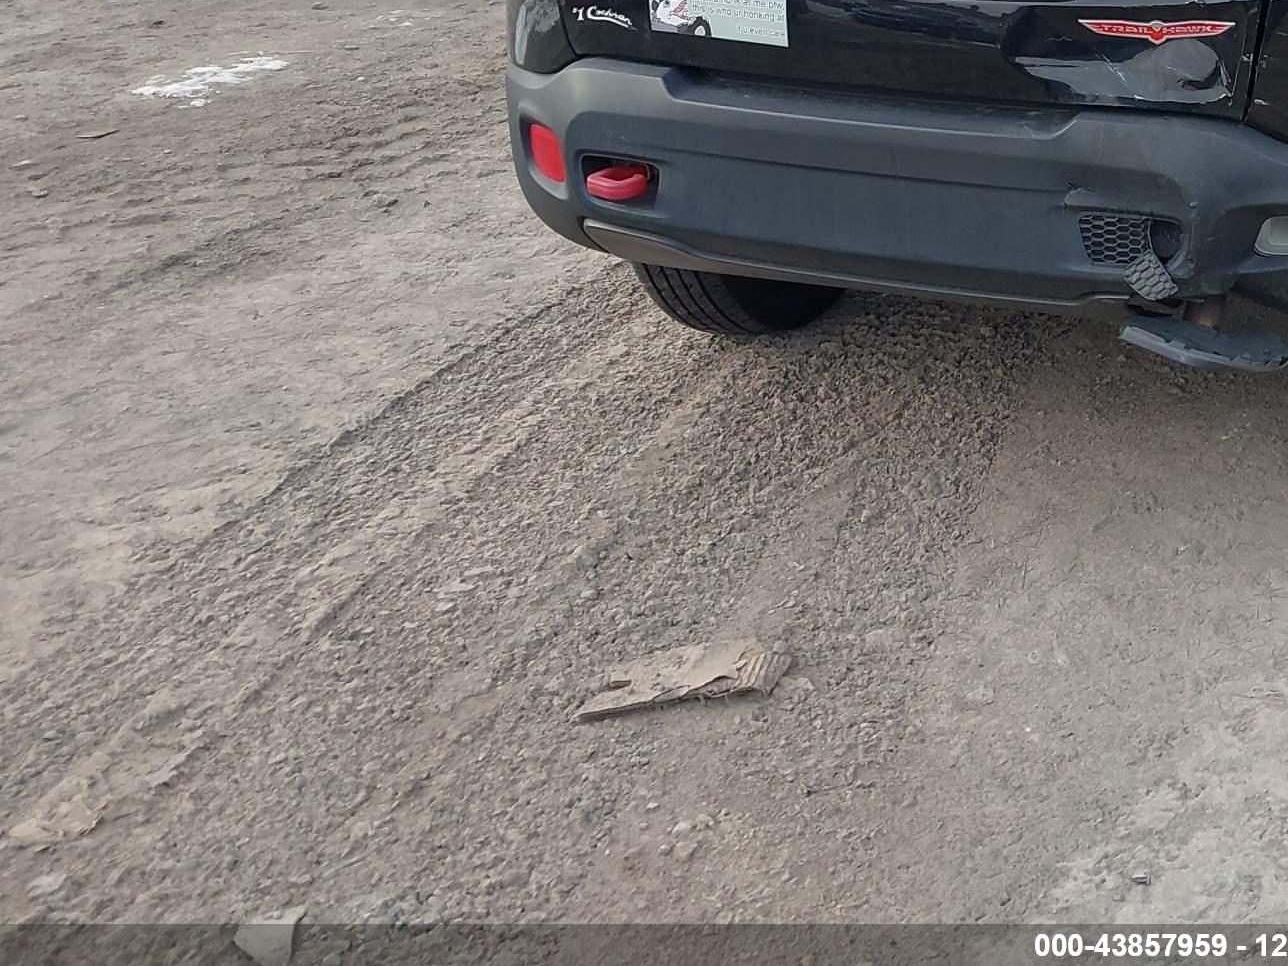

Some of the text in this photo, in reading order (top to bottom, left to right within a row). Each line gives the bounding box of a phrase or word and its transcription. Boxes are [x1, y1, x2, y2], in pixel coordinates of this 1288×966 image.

[753, 0, 766, 8] me
[692, 4, 706, 13] this
[743, 10, 775, 22] honking
